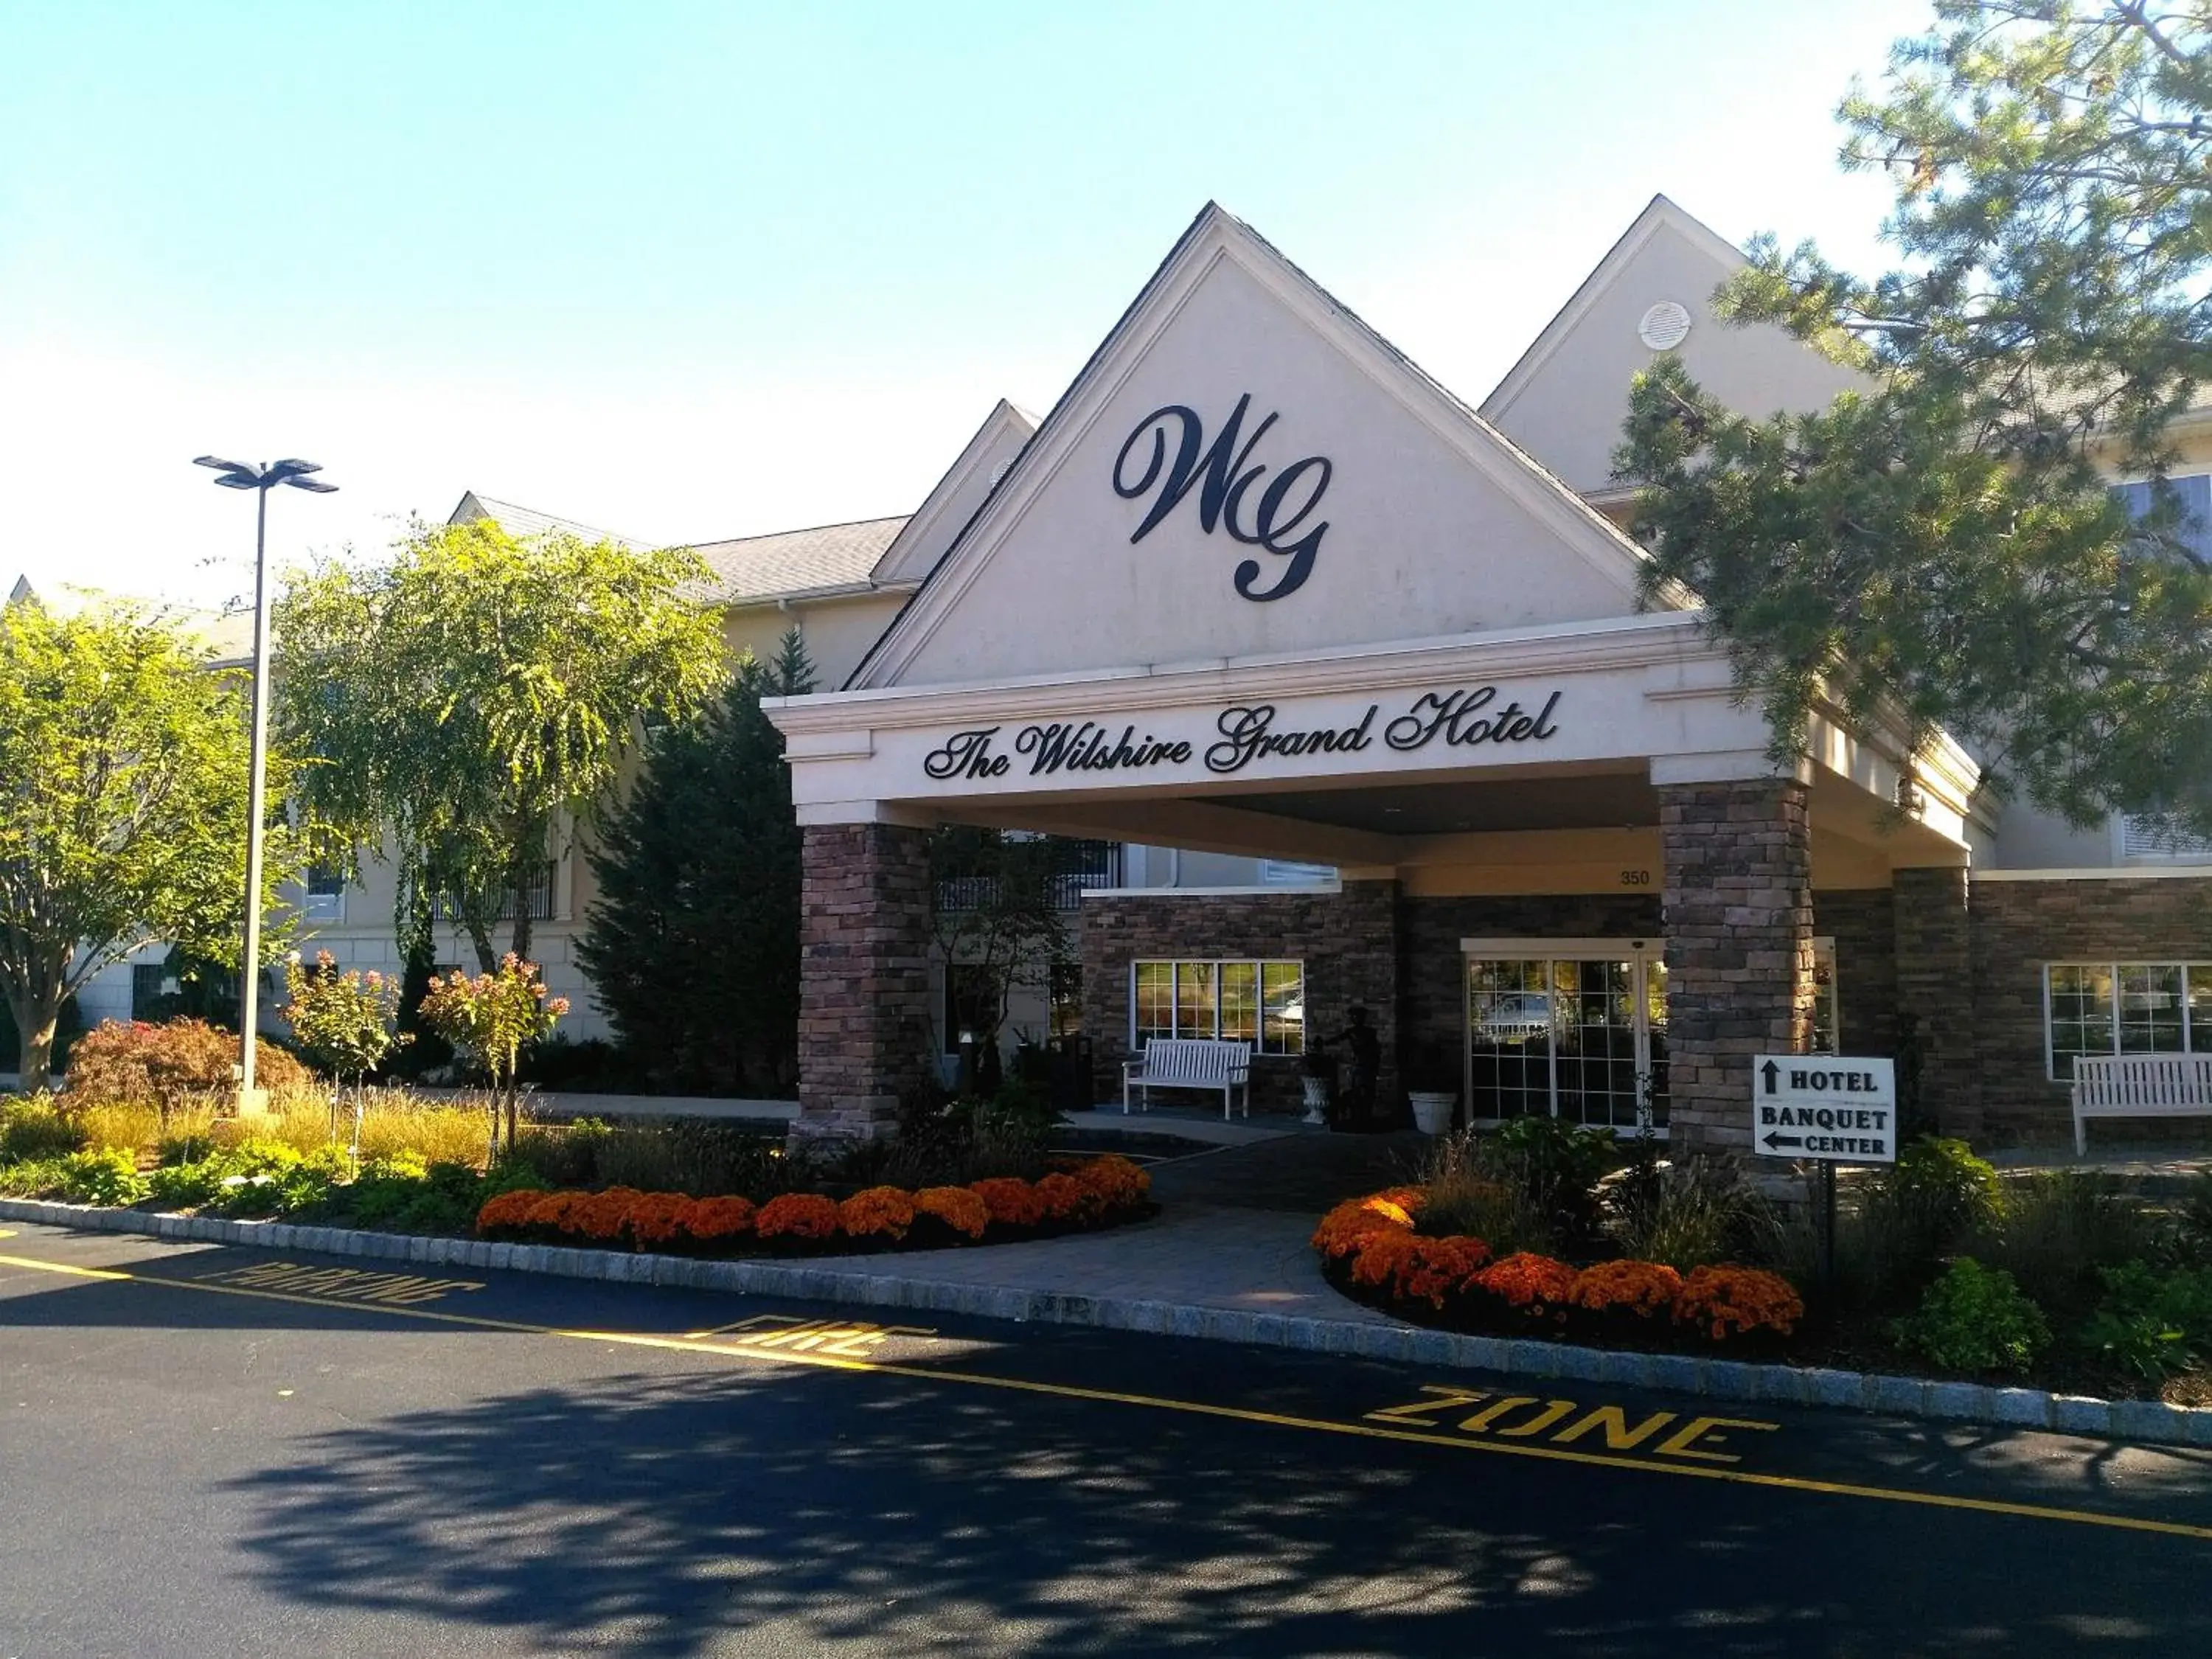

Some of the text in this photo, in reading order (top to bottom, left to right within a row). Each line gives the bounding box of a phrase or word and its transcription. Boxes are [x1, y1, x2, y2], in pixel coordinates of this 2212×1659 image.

[924, 686, 1562, 780] The Wilshire Grand Hotel
[1620, 870, 1650, 886] 350
[1790, 1070, 1878, 1092] HOTEL
[1761, 1107, 1888, 1130] BANQUET
[1805, 1135, 1885, 1155] CENTER
[683, 1314, 939, 1356] FIRE
[1362, 1385, 1781, 1463] ZONE
